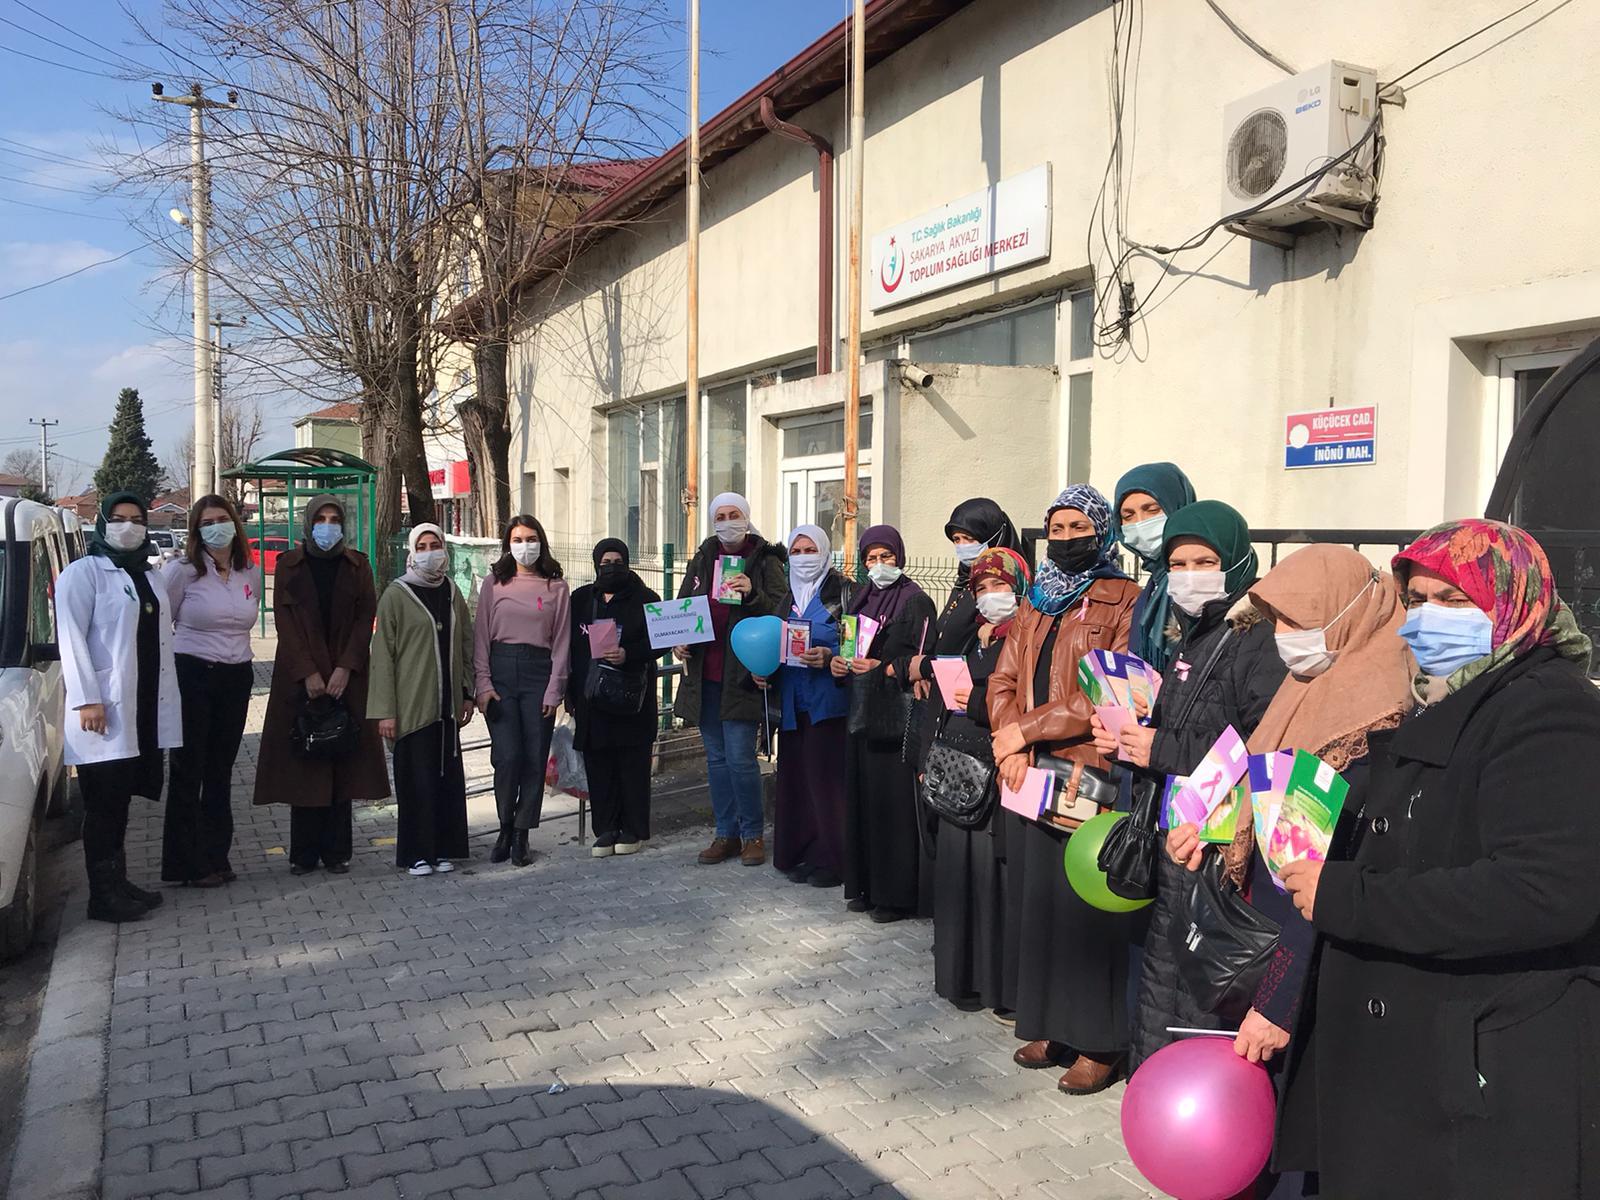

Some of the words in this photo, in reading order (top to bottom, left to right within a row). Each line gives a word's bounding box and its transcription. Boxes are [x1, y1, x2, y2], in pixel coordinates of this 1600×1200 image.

[1309, 86, 1321, 97] LG
[1295, 99, 1322, 115] BEKO
[923, 222, 946, 239] Sağlık
[947, 207, 982, 230] Bakanlığı
[909, 241, 946, 264] SAKARYA
[949, 228, 981, 250] AKYAZI
[908, 260, 945, 284] TOPLUM
[945, 246, 983, 271] SAĞLIĞI
[984, 228, 1030, 258] MERKEZİ
[1312, 413, 1352, 431] KÜÇÜCEK
[1353, 412, 1373, 427] CAD.
[1314, 445, 1344, 461] İNÖNÜ
[1346, 445, 1372, 460] MAH.
